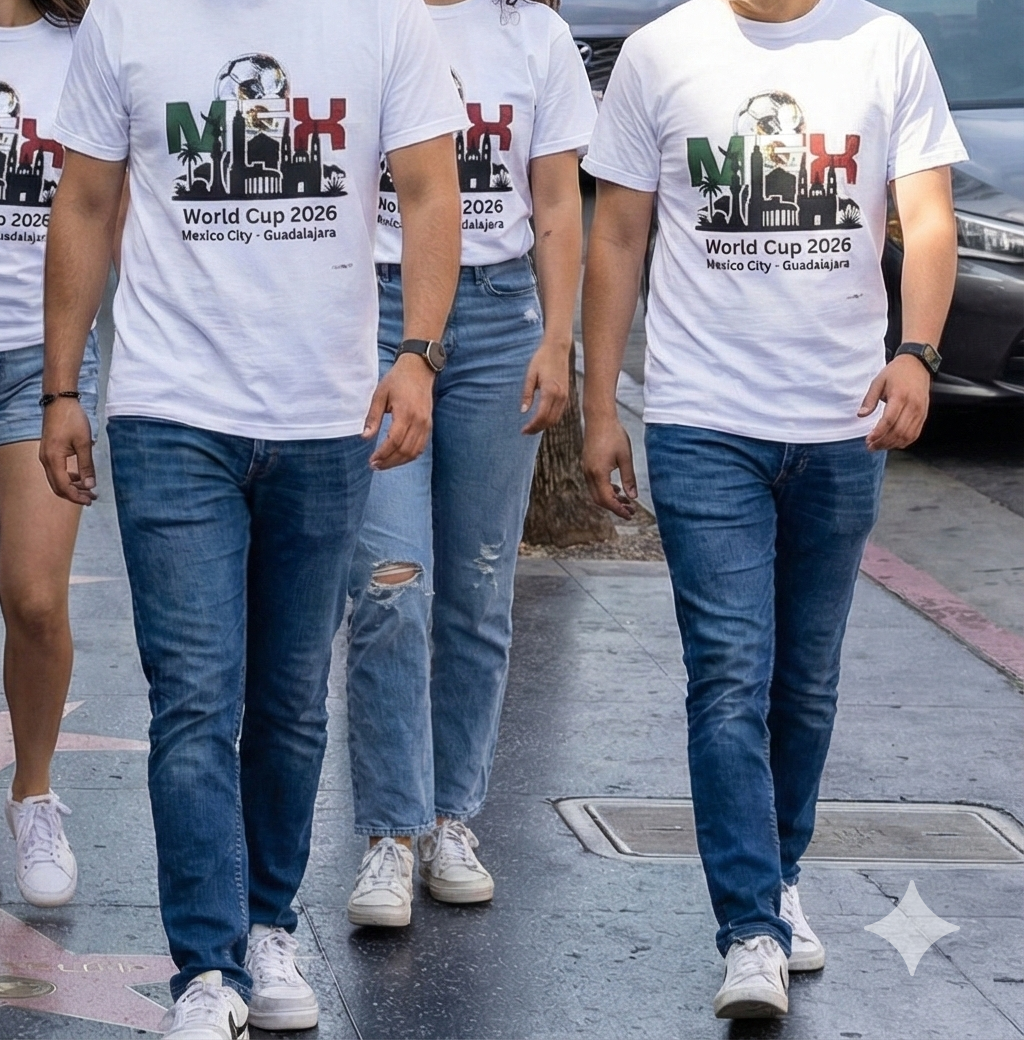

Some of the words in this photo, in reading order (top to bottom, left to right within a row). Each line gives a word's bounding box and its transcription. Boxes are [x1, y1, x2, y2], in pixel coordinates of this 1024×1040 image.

[462, 199, 504, 214] 2026
[183, 207, 240, 225] World
[246, 208, 285, 228] Cup
[290, 205, 338, 222] 2026
[181, 229, 224, 242] Mexico
[263, 227, 336, 242] Guadalajara
[705, 238, 758, 255] World
[764, 239, 802, 258] Cup
[807, 237, 852, 254] 2026
[747, 260, 772, 274] City
